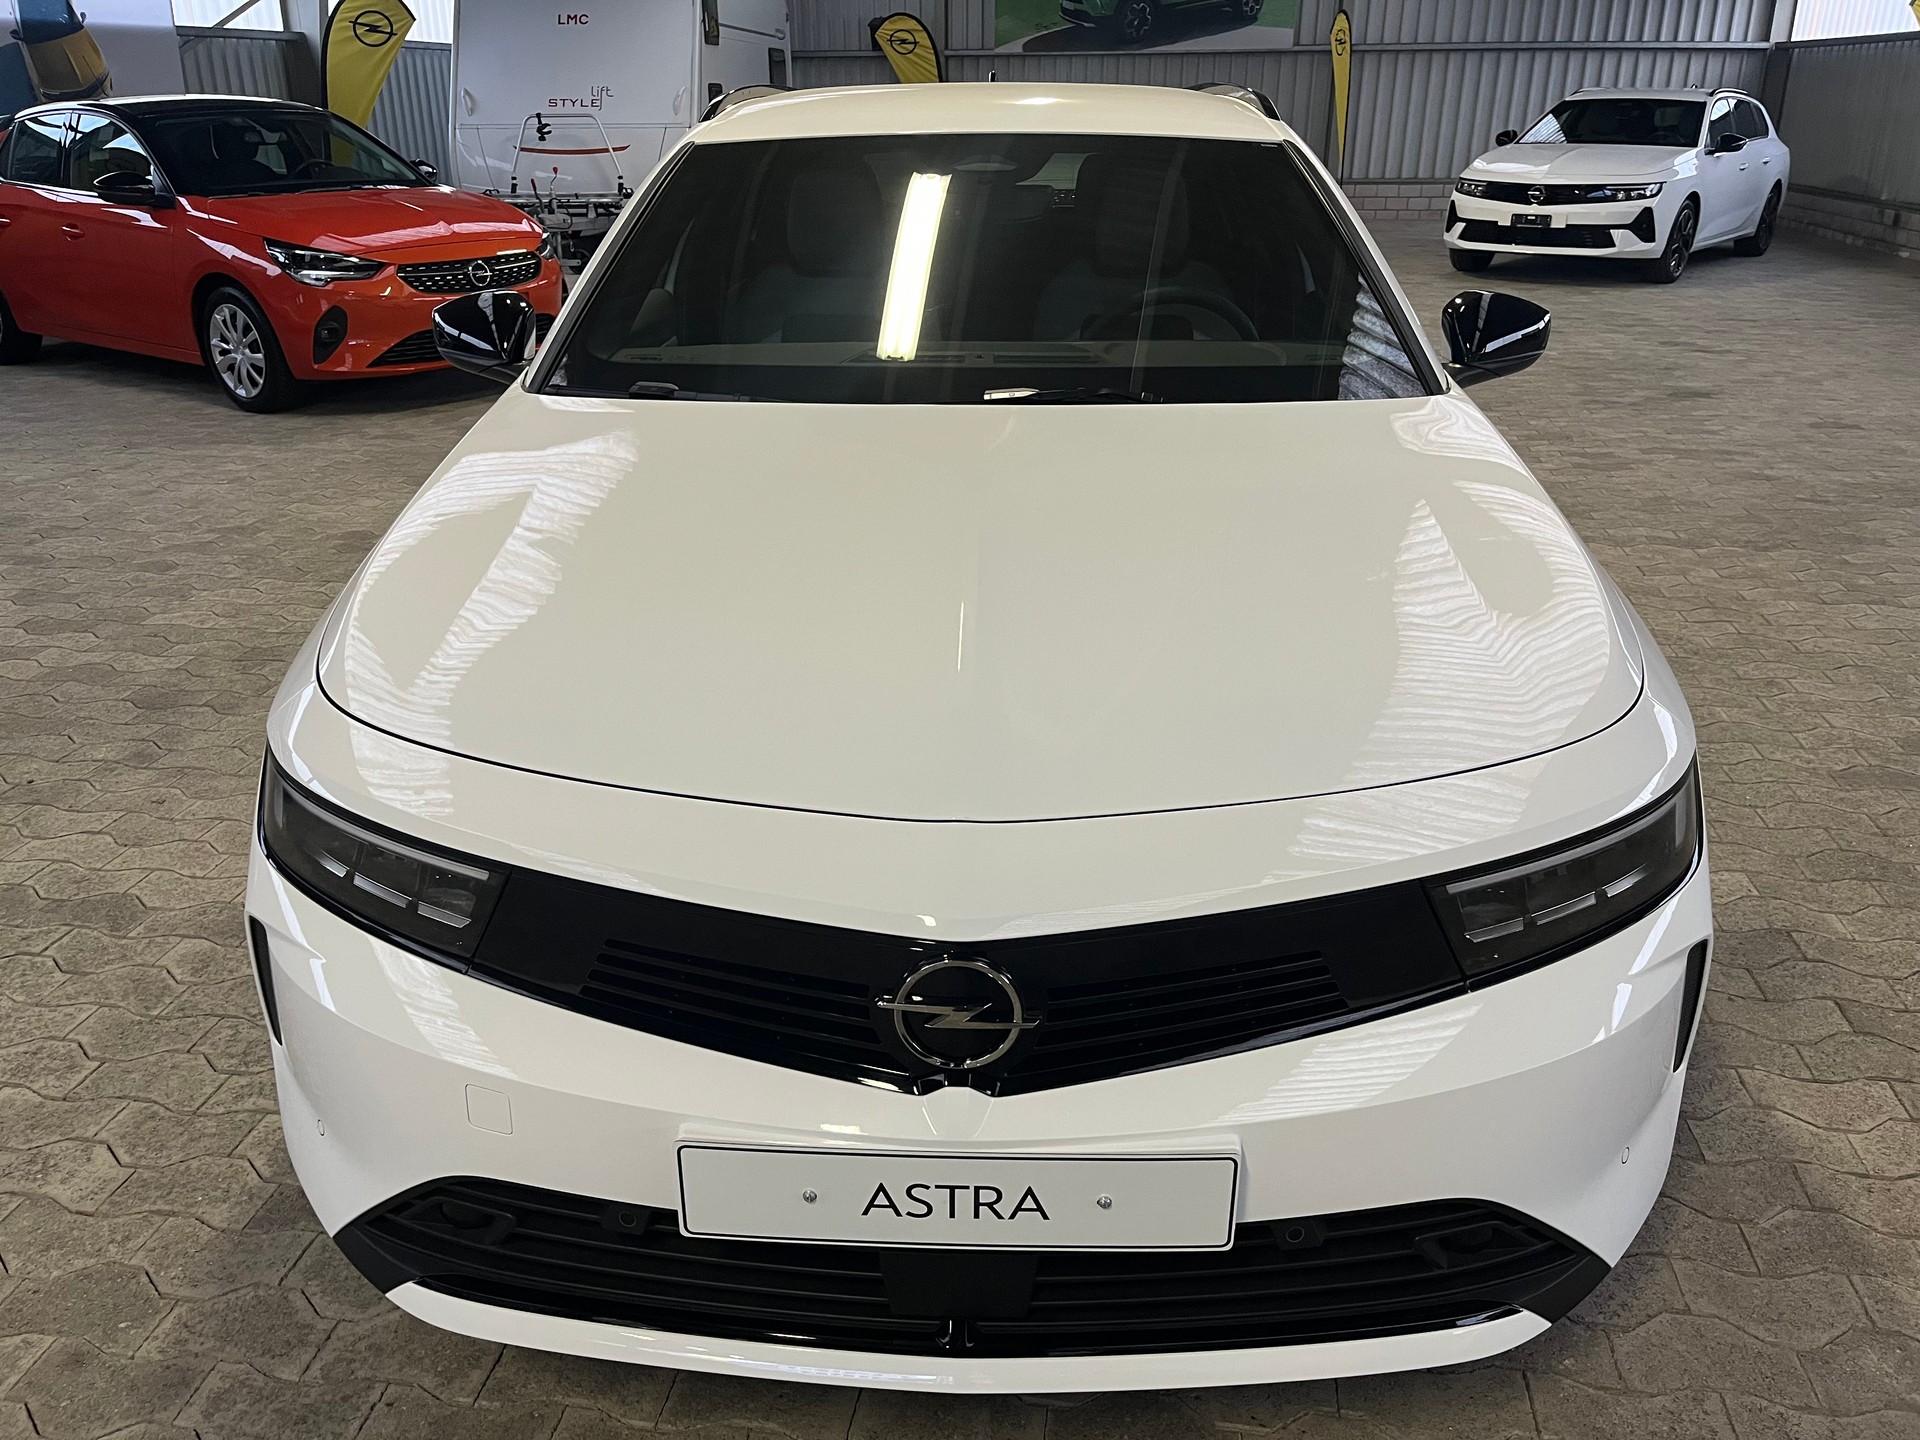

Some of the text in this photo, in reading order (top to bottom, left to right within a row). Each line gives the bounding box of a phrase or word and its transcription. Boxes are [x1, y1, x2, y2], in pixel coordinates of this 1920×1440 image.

[557, 14, 589, 25] LMC
[548, 86, 614, 111] STYLE lift
[861, 1182, 1051, 1220] ASTRA
